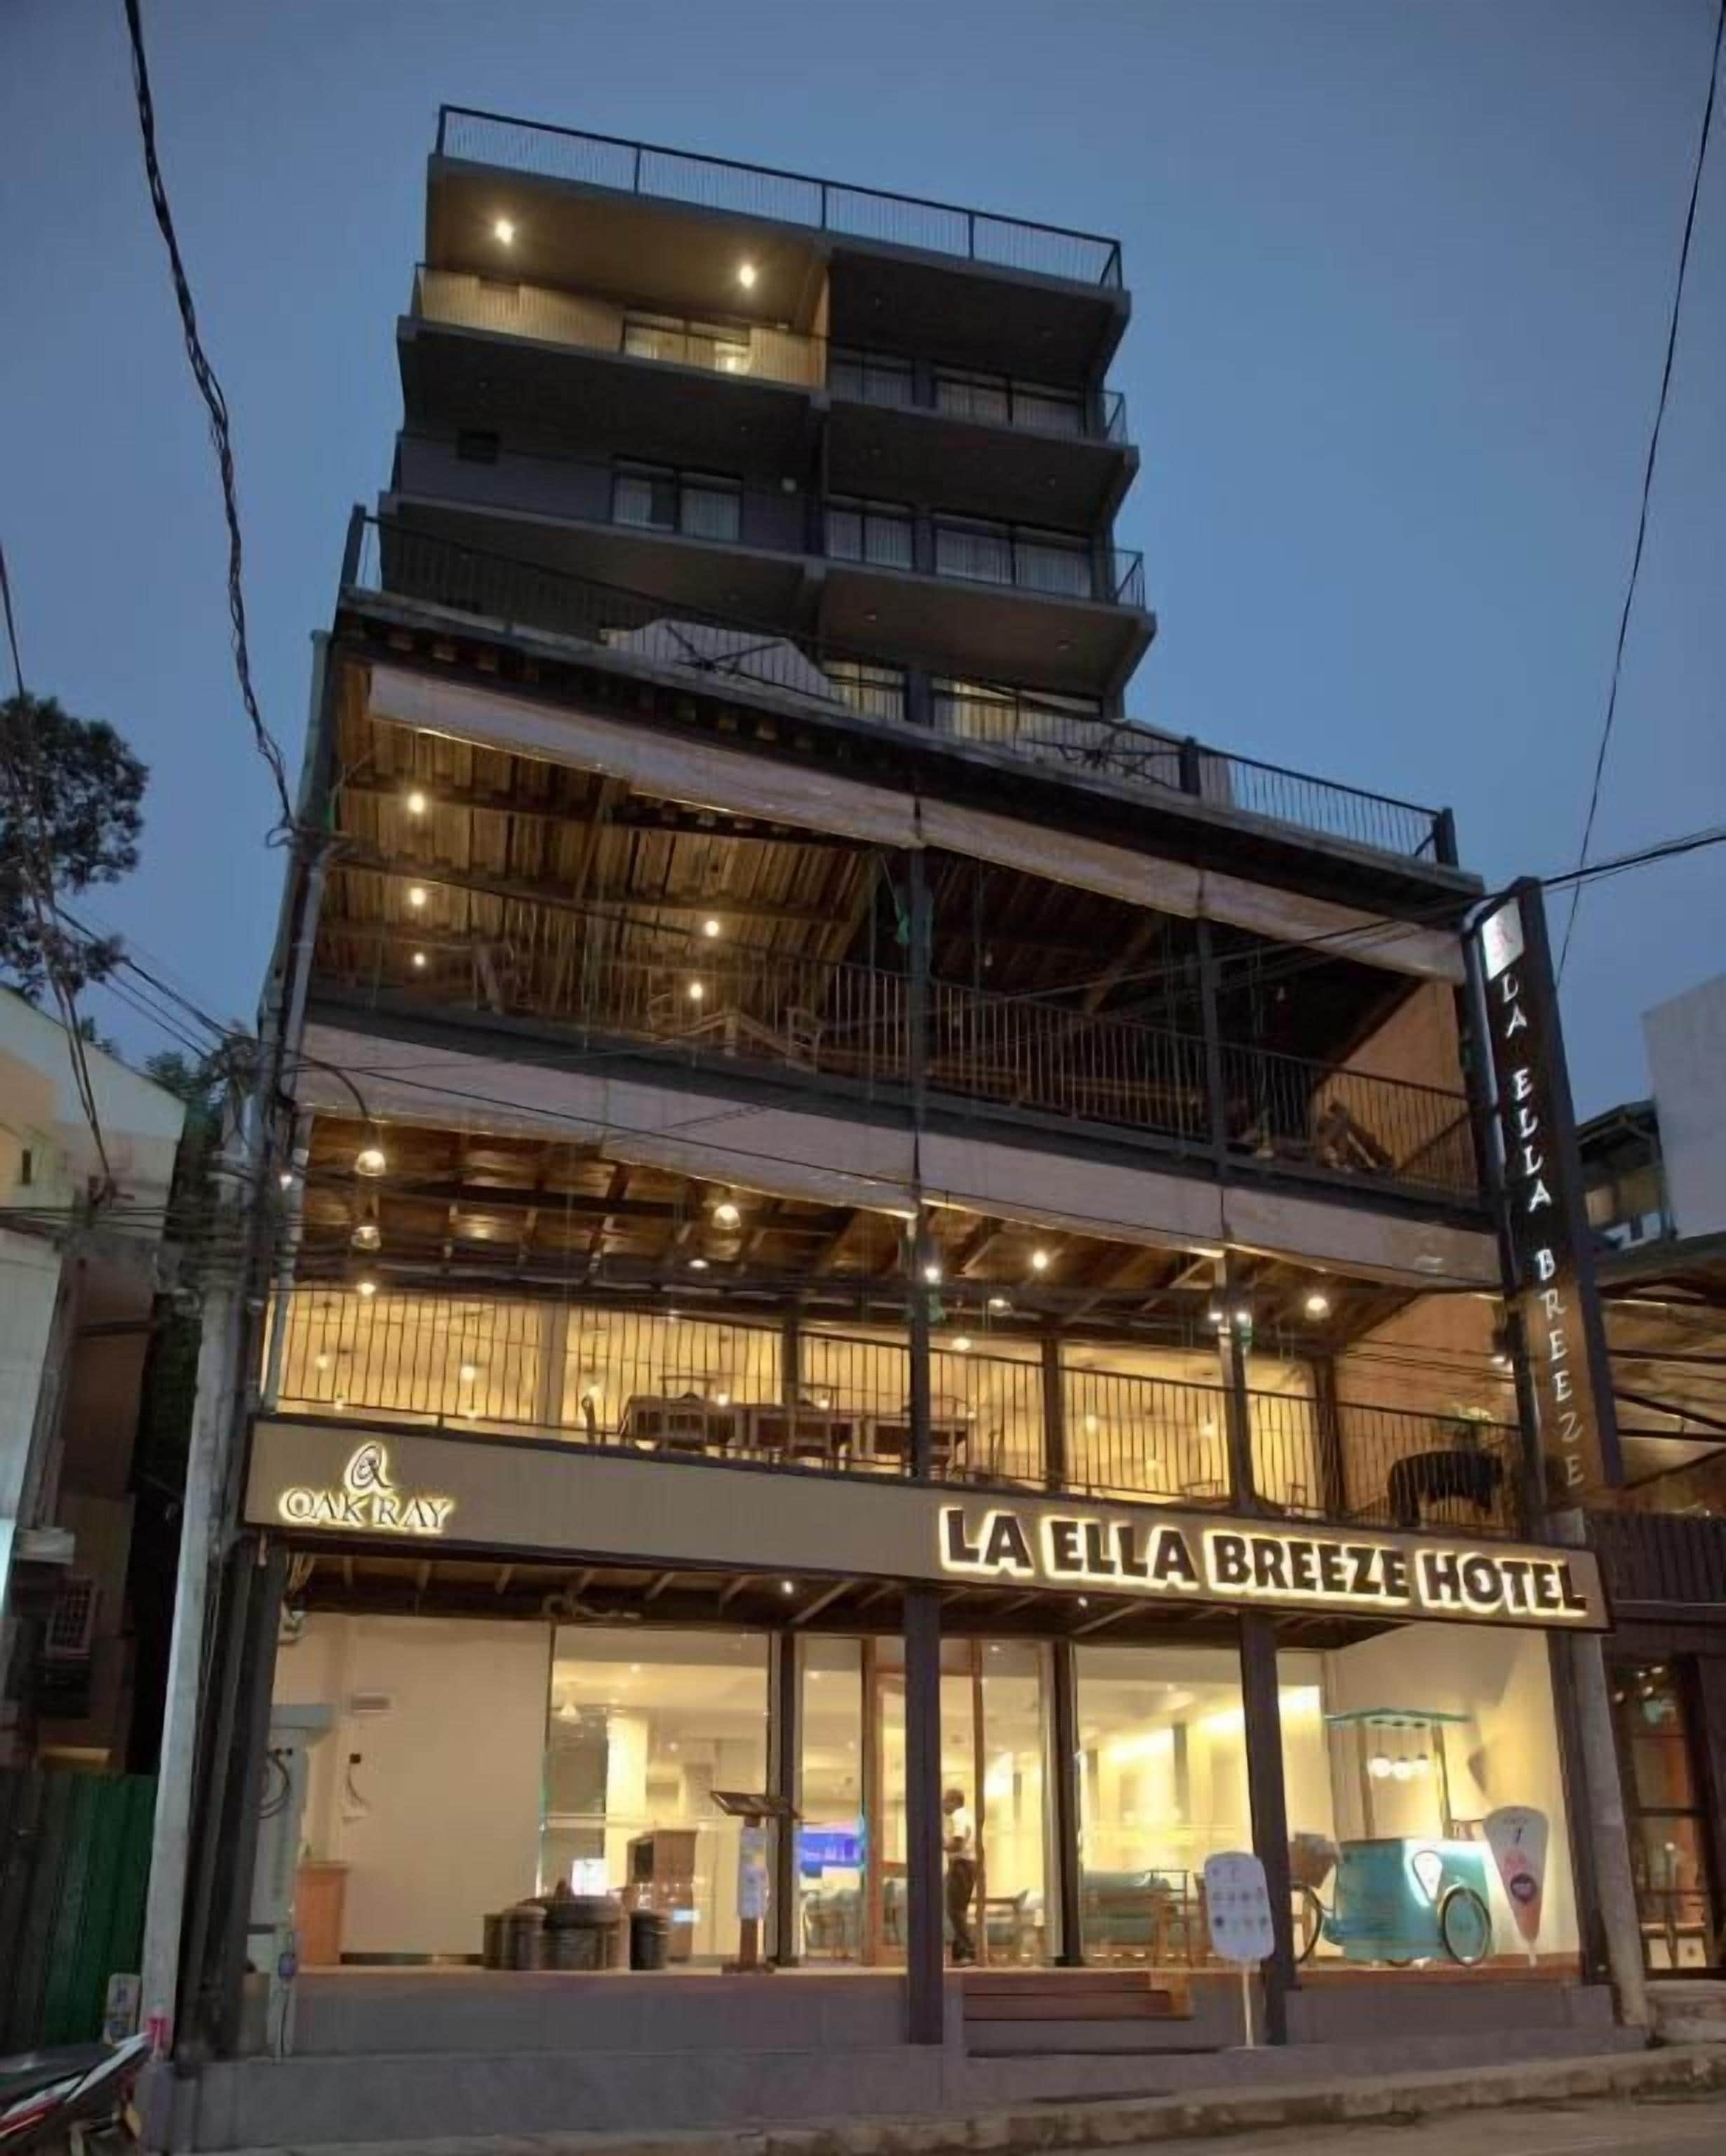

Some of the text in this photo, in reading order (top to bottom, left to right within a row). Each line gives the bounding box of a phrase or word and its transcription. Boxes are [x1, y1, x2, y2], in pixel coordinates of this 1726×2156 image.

[1502, 973, 1584, 1486] LA ELLA BREEZE
[941, 1508, 1587, 1616] LA ELLA BREEZE HOTEL
